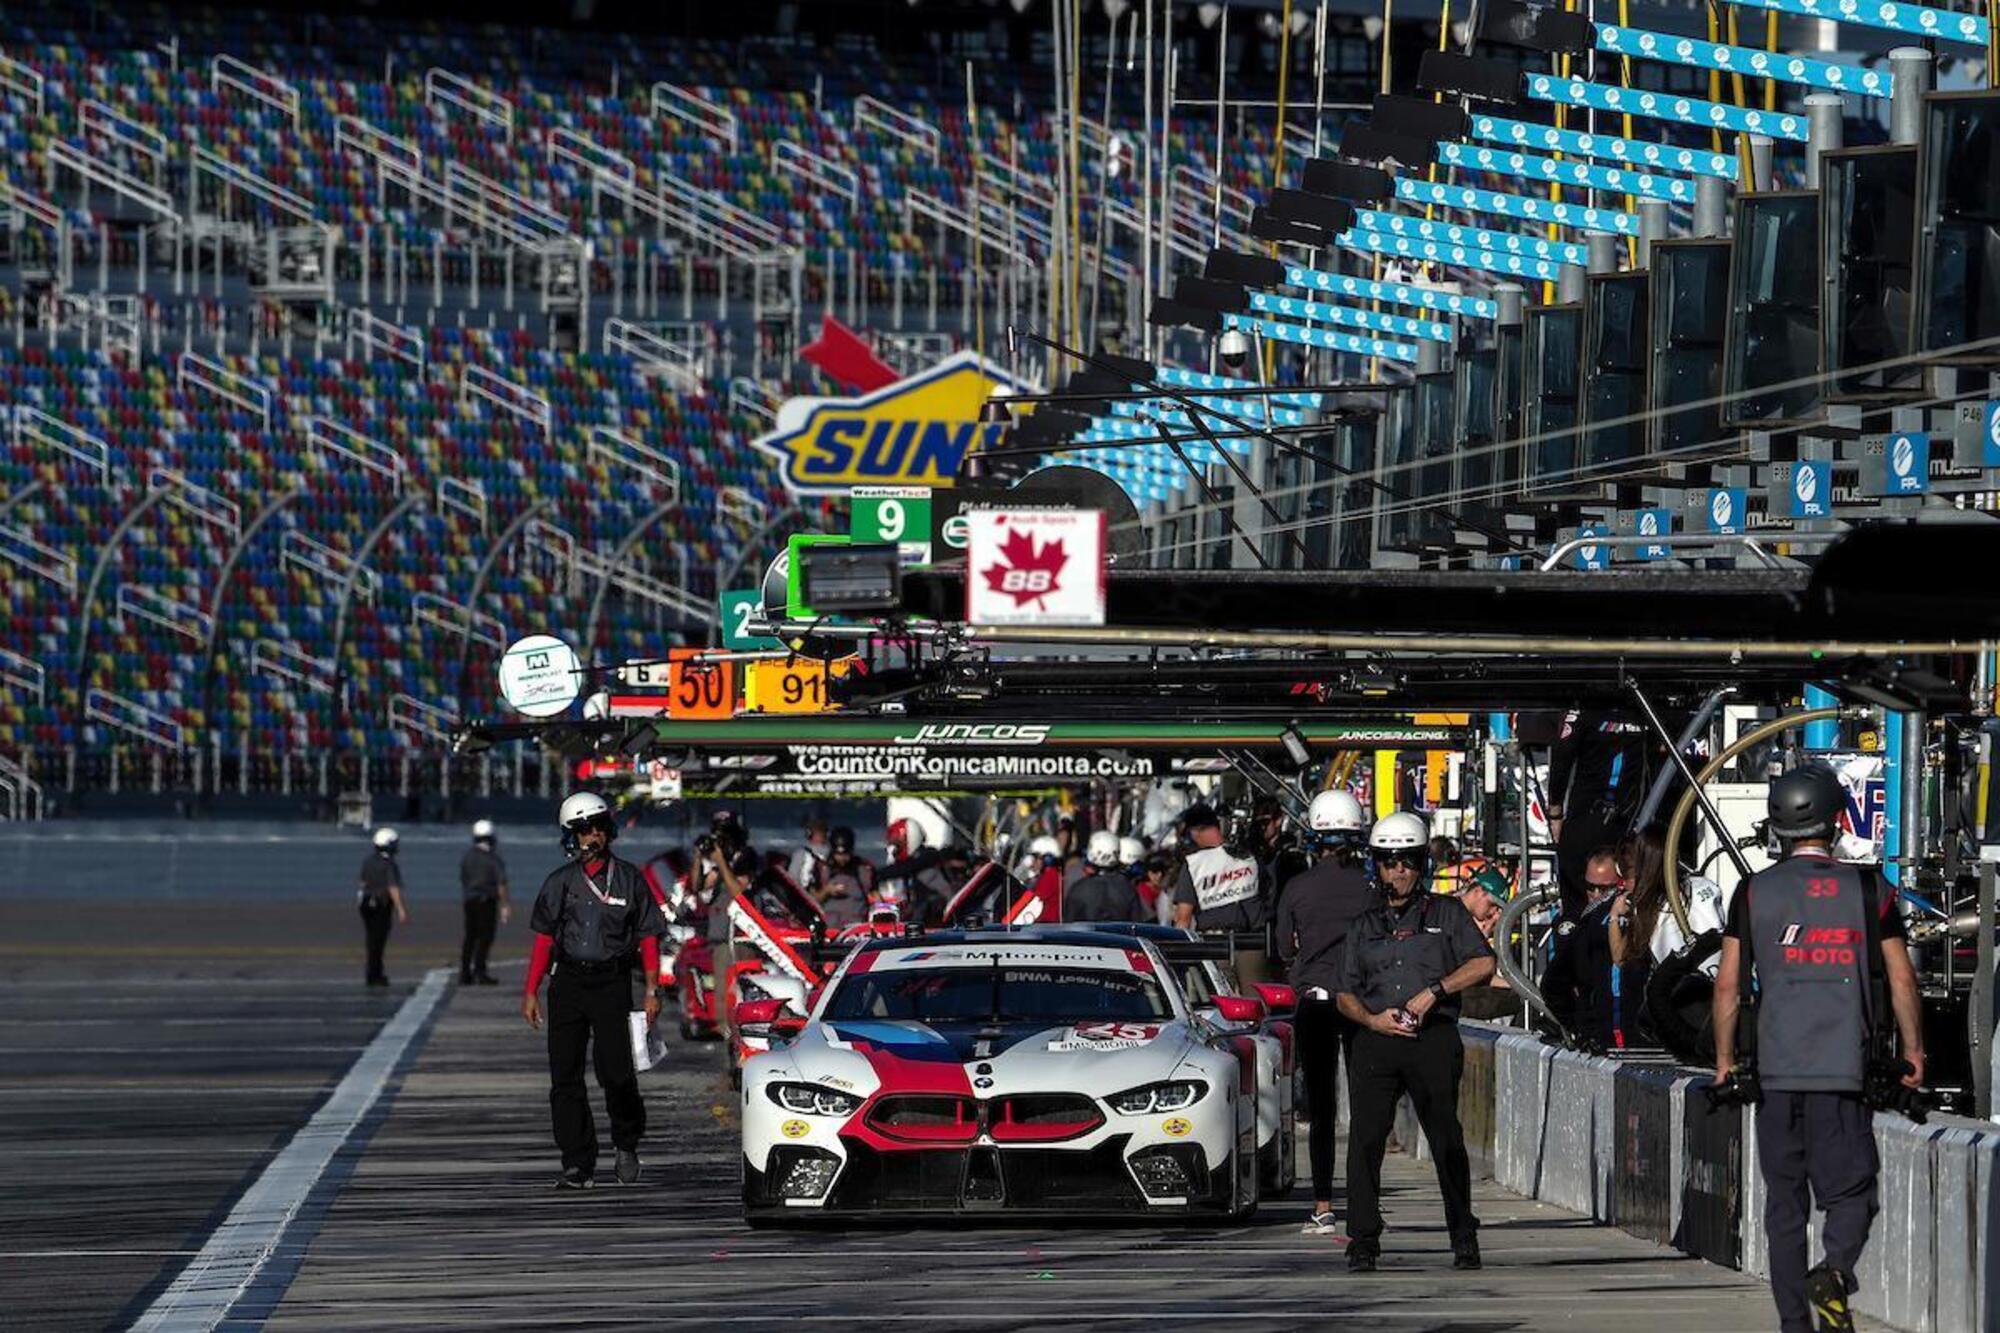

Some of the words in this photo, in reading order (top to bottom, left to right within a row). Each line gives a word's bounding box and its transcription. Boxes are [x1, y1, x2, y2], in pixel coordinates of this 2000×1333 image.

[877, 499, 905, 541] 9
[1003, 570, 1052, 592] 88
[679, 661, 724, 708] 50
[1805, 878, 1840, 898] 33
[965, 951, 1104, 962] Motorsport
[1785, 947, 1857, 966] PHOTO
